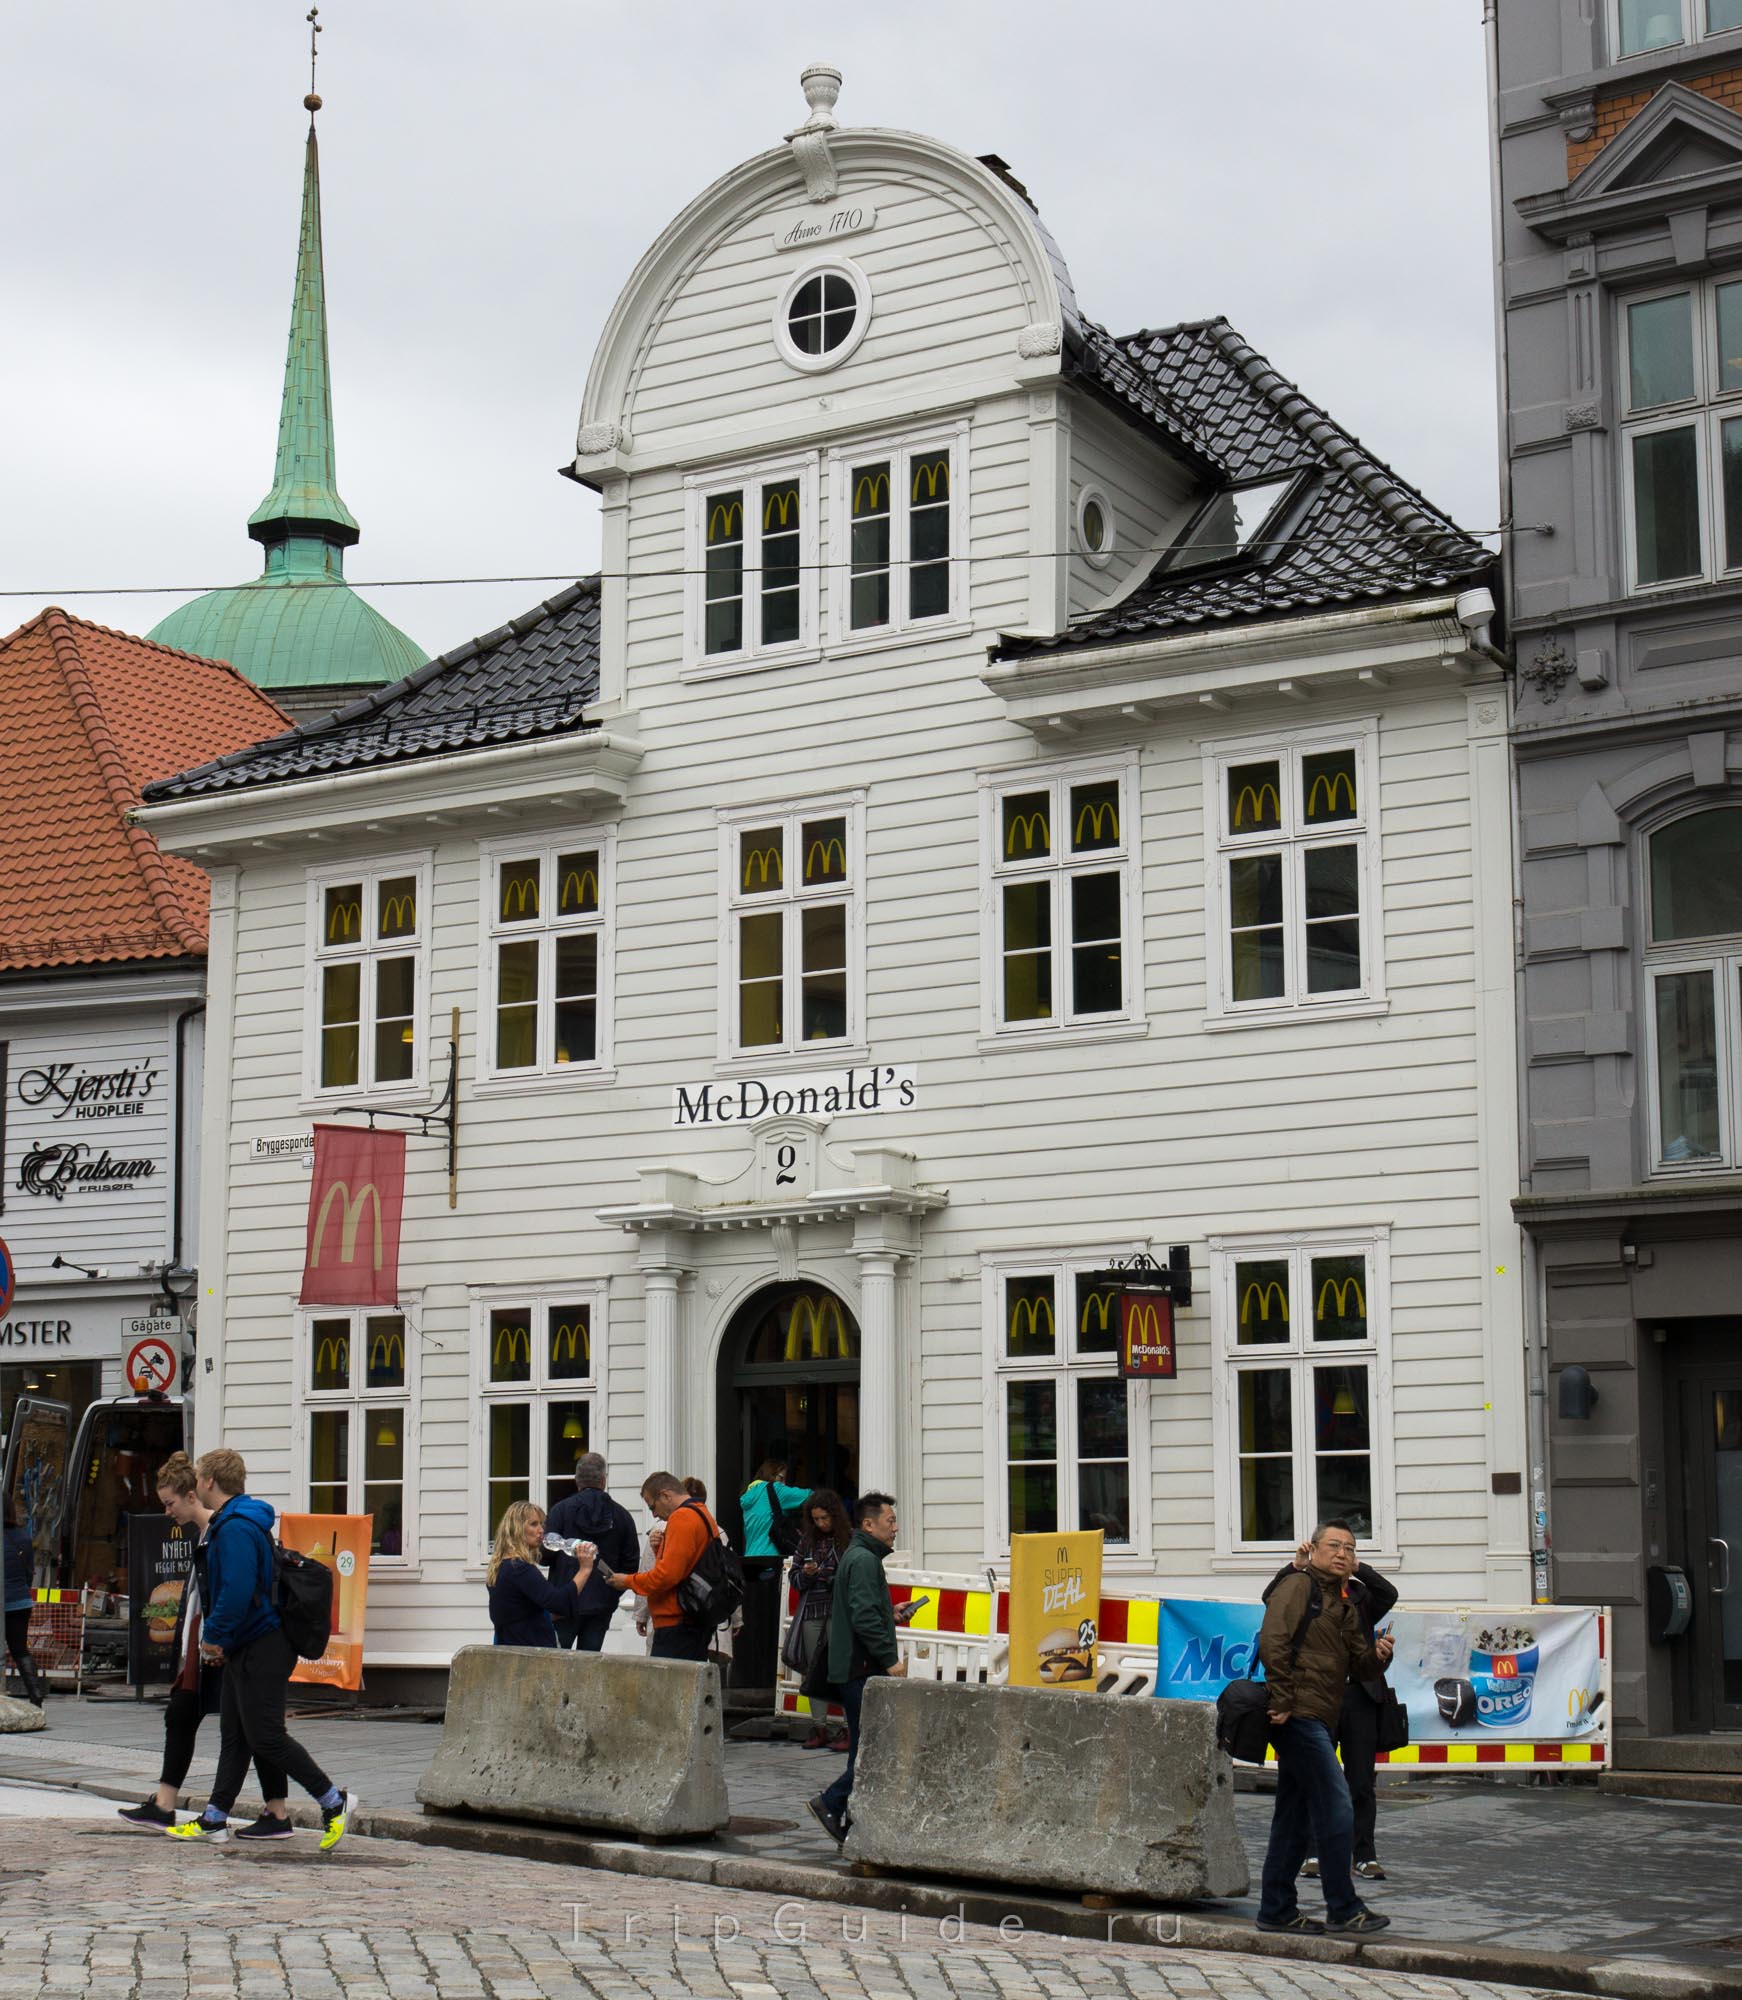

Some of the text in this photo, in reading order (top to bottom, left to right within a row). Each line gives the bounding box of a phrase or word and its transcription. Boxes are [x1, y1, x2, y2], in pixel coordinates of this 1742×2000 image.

[784, 208, 863, 245] Anno 1710
[18, 1057, 158, 1119] Kjersti's
[673, 1066, 916, 1125] McDonald's
[75, 1103, 144, 1119] HUDPLEIE
[34, 1142, 156, 1184] Balsam
[776, 1145, 797, 1186] 2
[78, 1183, 134, 1193] FRISØR
[1131, 1344, 1171, 1356] McDonald's
[162, 1540, 192, 1560] NYHET!
[340, 1556, 353, 1569] 29
[1044, 1567, 1083, 1587] SUPER
[1042, 1575, 1087, 1614] DEAL
[1477, 1686, 1531, 1714] OREO
